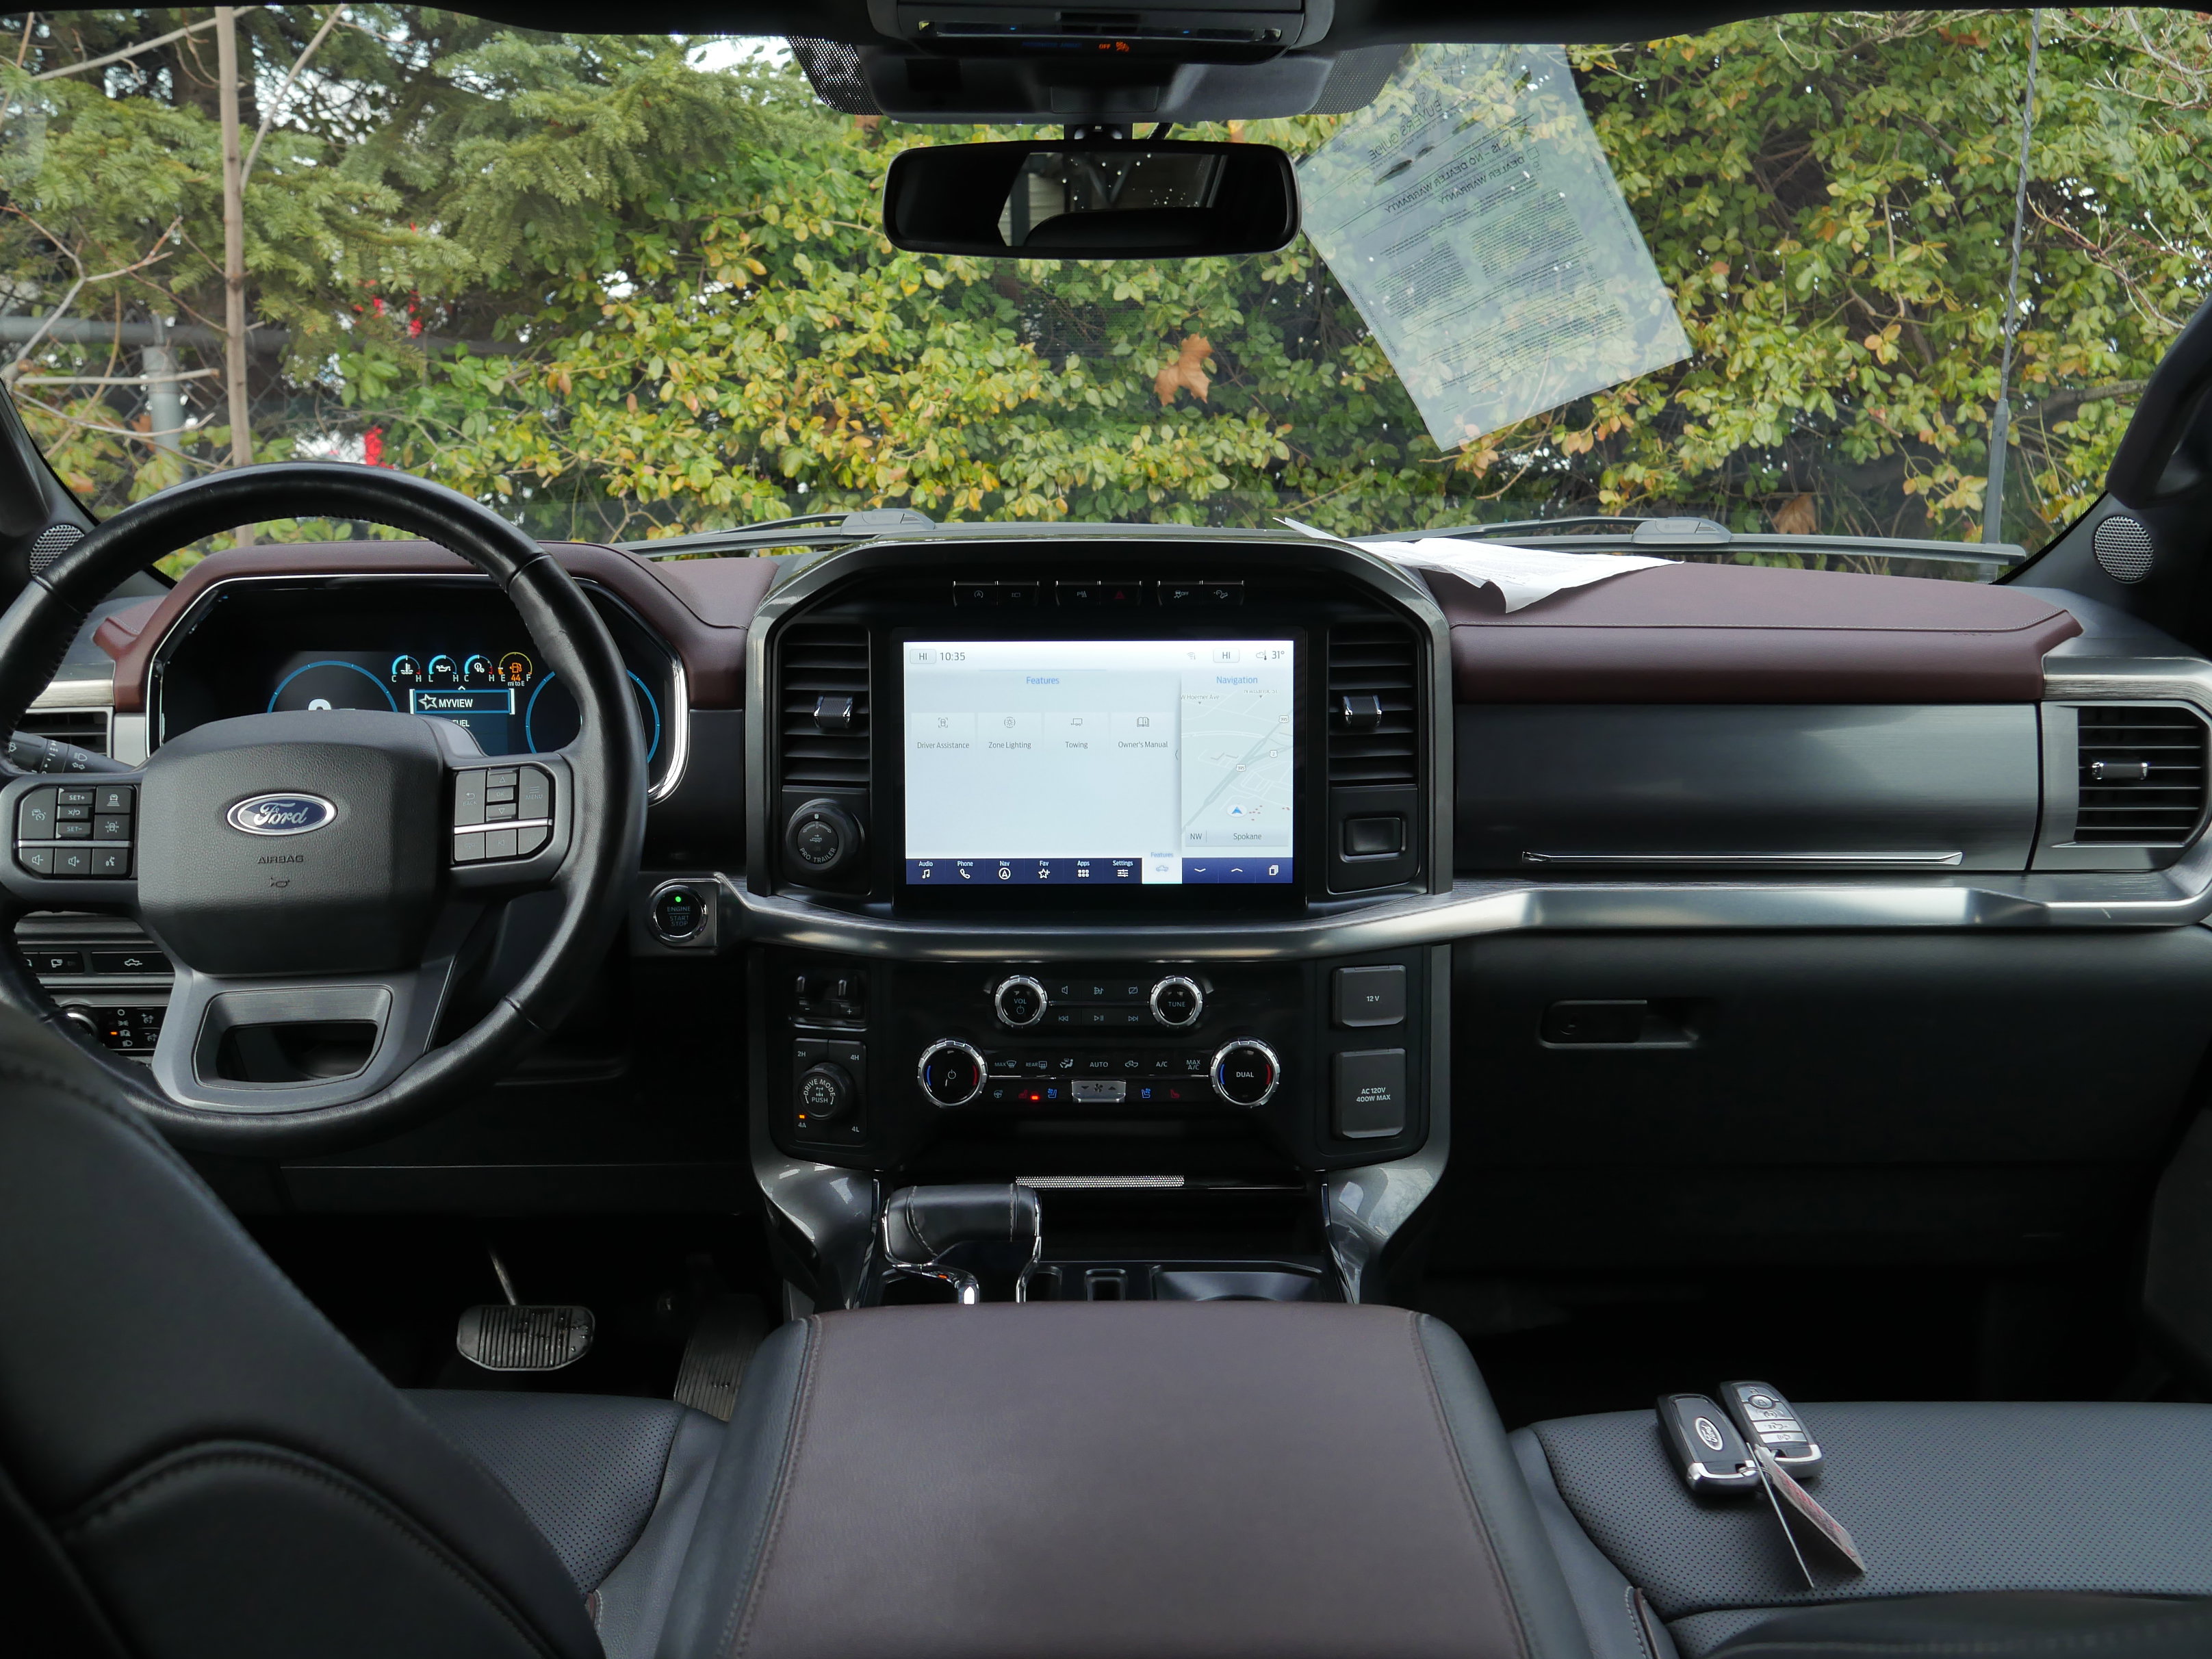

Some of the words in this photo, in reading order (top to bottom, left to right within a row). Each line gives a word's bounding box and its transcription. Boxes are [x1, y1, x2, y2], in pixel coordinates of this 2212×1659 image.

[940, 652, 966, 661] 10:35
[1272, 650, 1285, 659] 31°
[1216, 676, 1258, 685] Navigation
[439, 699, 473, 708] MYVIEW
[1005, 741, 1031, 750] Lighting
[1065, 741, 1088, 750] Towing
[253, 801, 307, 826] Ford
[1233, 832, 1262, 842] Spokane
[257, 855, 304, 864] AIRBAG
[799, 847, 811, 860] PRO
[813, 847, 836, 863] TRAILER
[803, 1079, 819, 1096] DRIVE
[820, 1079, 836, 1096] MODE
